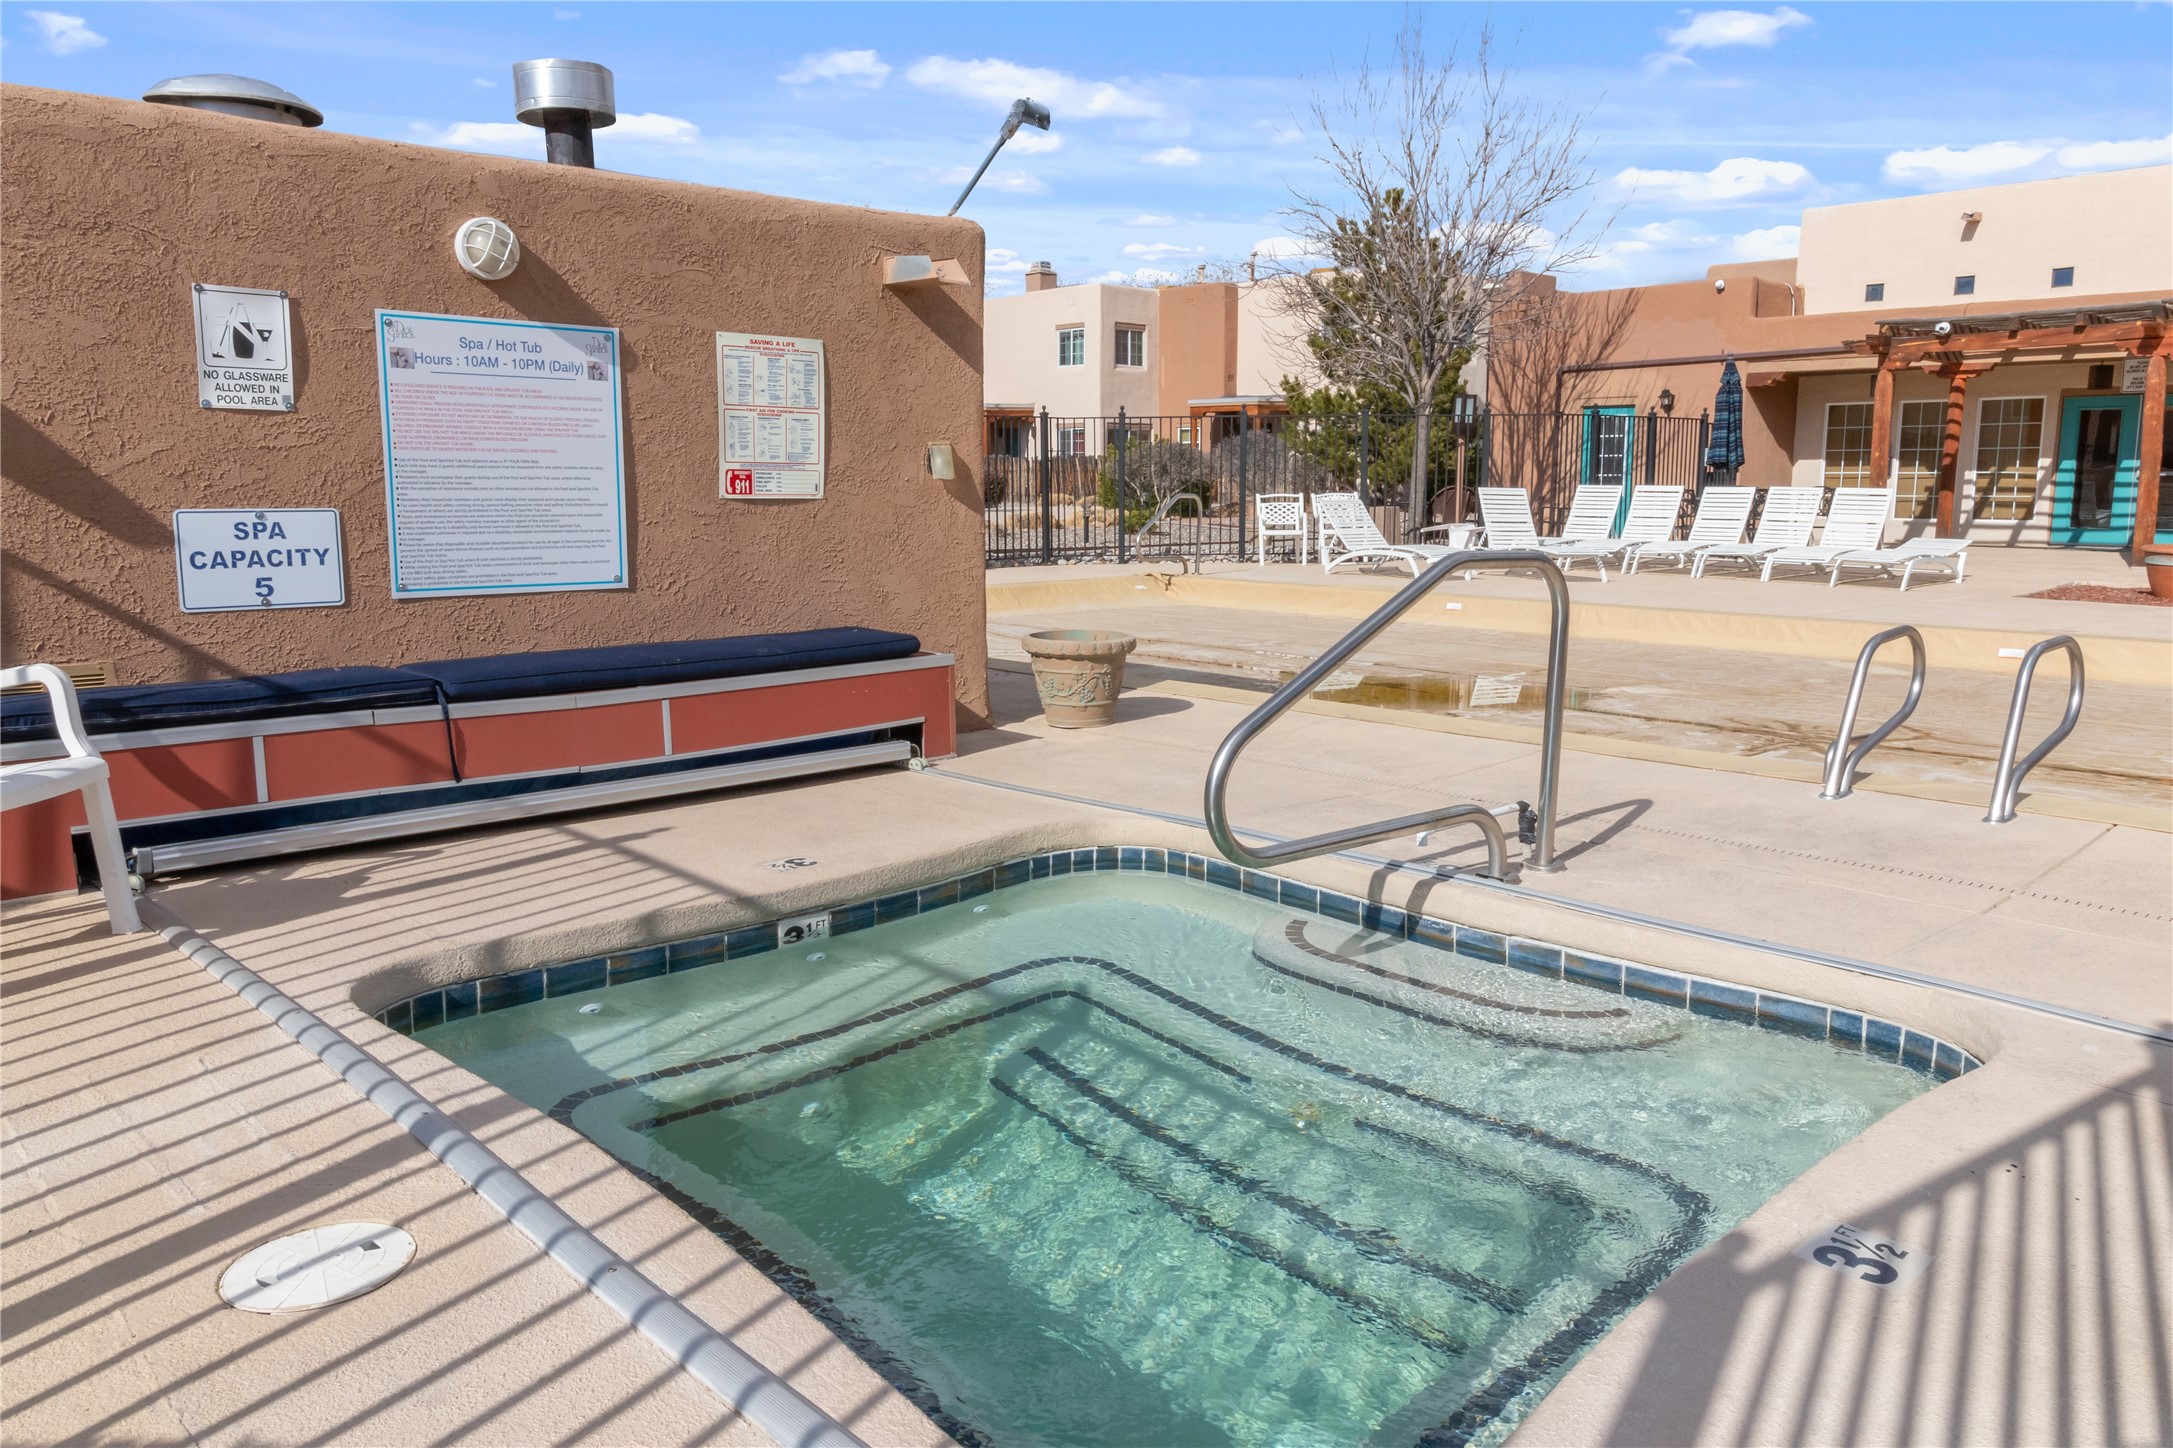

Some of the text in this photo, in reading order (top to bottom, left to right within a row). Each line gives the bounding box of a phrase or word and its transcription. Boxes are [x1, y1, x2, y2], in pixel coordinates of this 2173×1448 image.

[459, 336, 486, 352] Spa
[496, 340, 518, 352] Hot
[520, 341, 542, 354] Tub
[414, 352, 452, 366] Hours
[464, 356, 499, 369] 10AM
[512, 359, 546, 372] 10PM
[548, 360, 584, 376] (Daily)
[203, 370, 289, 383] NO GLASSWARE
[214, 382, 280, 394] ALLOWED IN
[216, 394, 279, 406] POOL AREA
[735, 479, 750, 494] 911
[233, 521, 288, 541] SPA
[188, 548, 330, 570] CAPACITY
[254, 576, 275, 598] 5
[1834, 1225, 1856, 1238] FT
